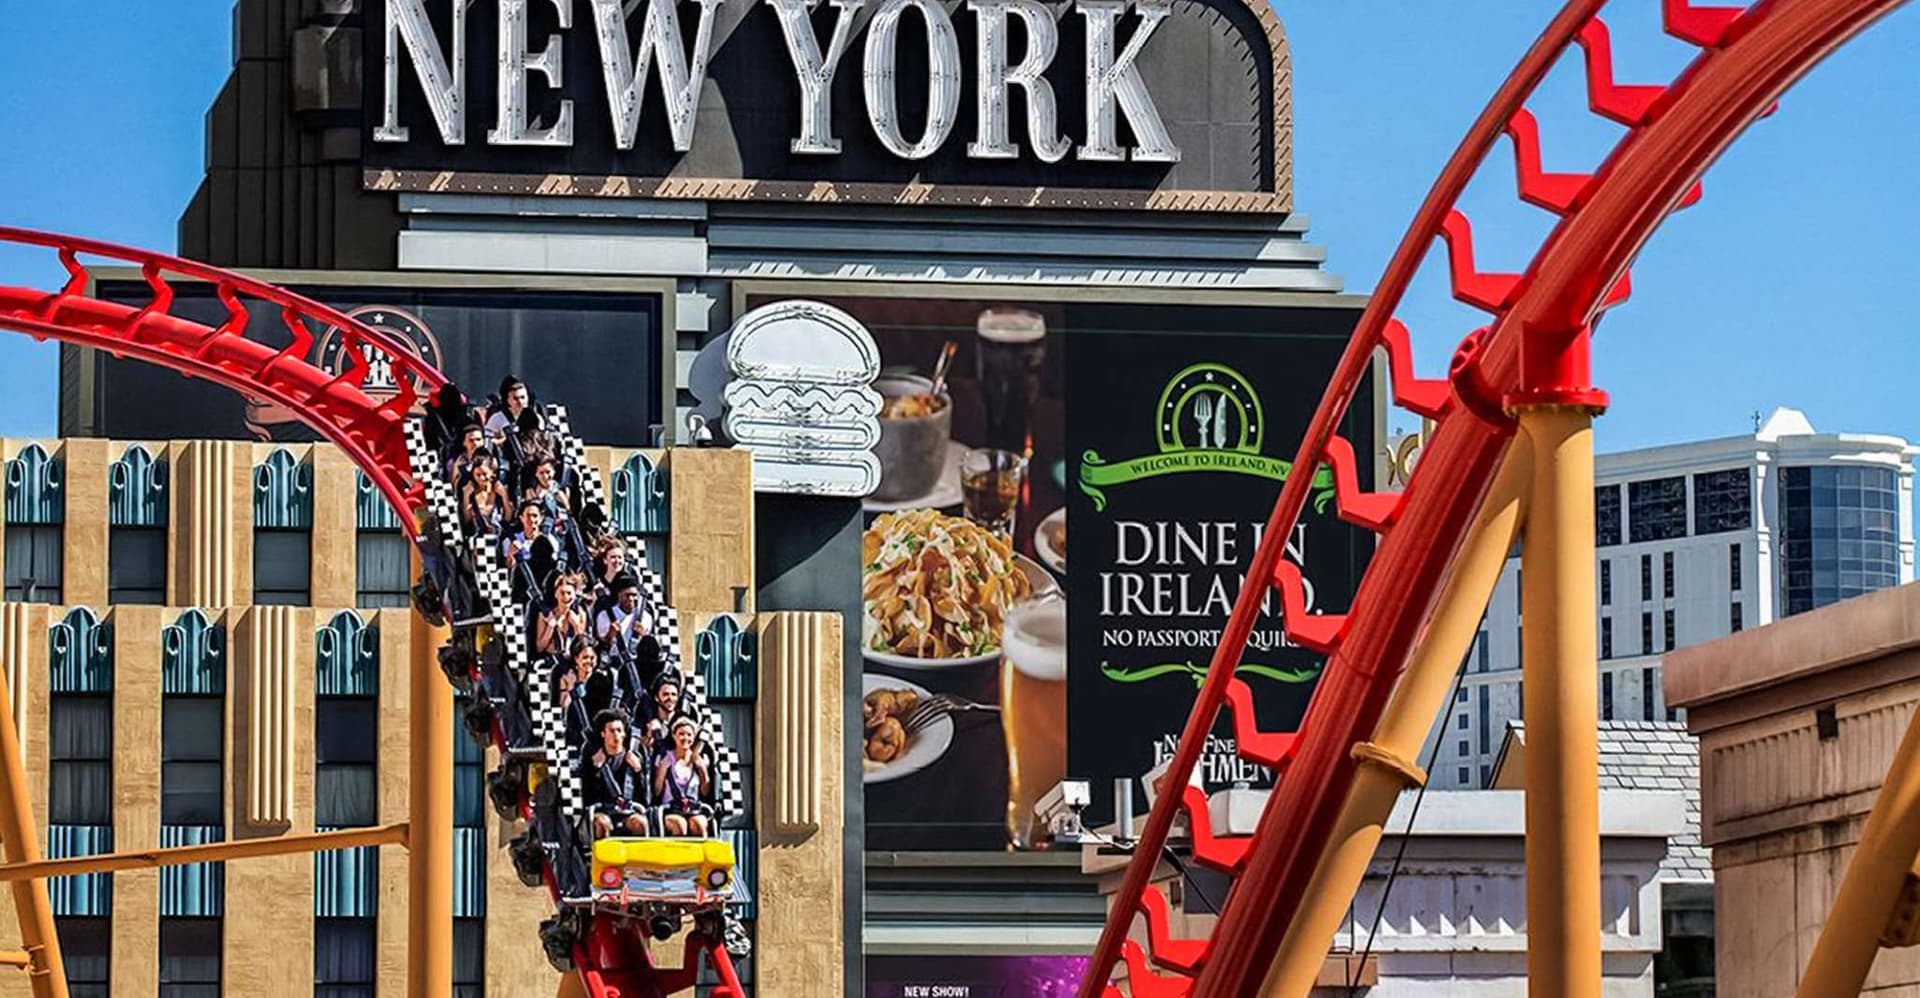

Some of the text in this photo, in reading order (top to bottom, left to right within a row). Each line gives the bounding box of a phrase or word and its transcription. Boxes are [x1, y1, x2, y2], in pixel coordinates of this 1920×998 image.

[373, 0, 1181, 162] NEW YORK
[1130, 455, 1190, 474] WELCOME
[1193, 455, 1210, 465] TO
[1114, 521, 1238, 566] DINE
[1103, 630, 1133, 647] NO
[1137, 630, 1220, 647] PASSPORT
[904, 985, 969, 998] NEW SHOW!
